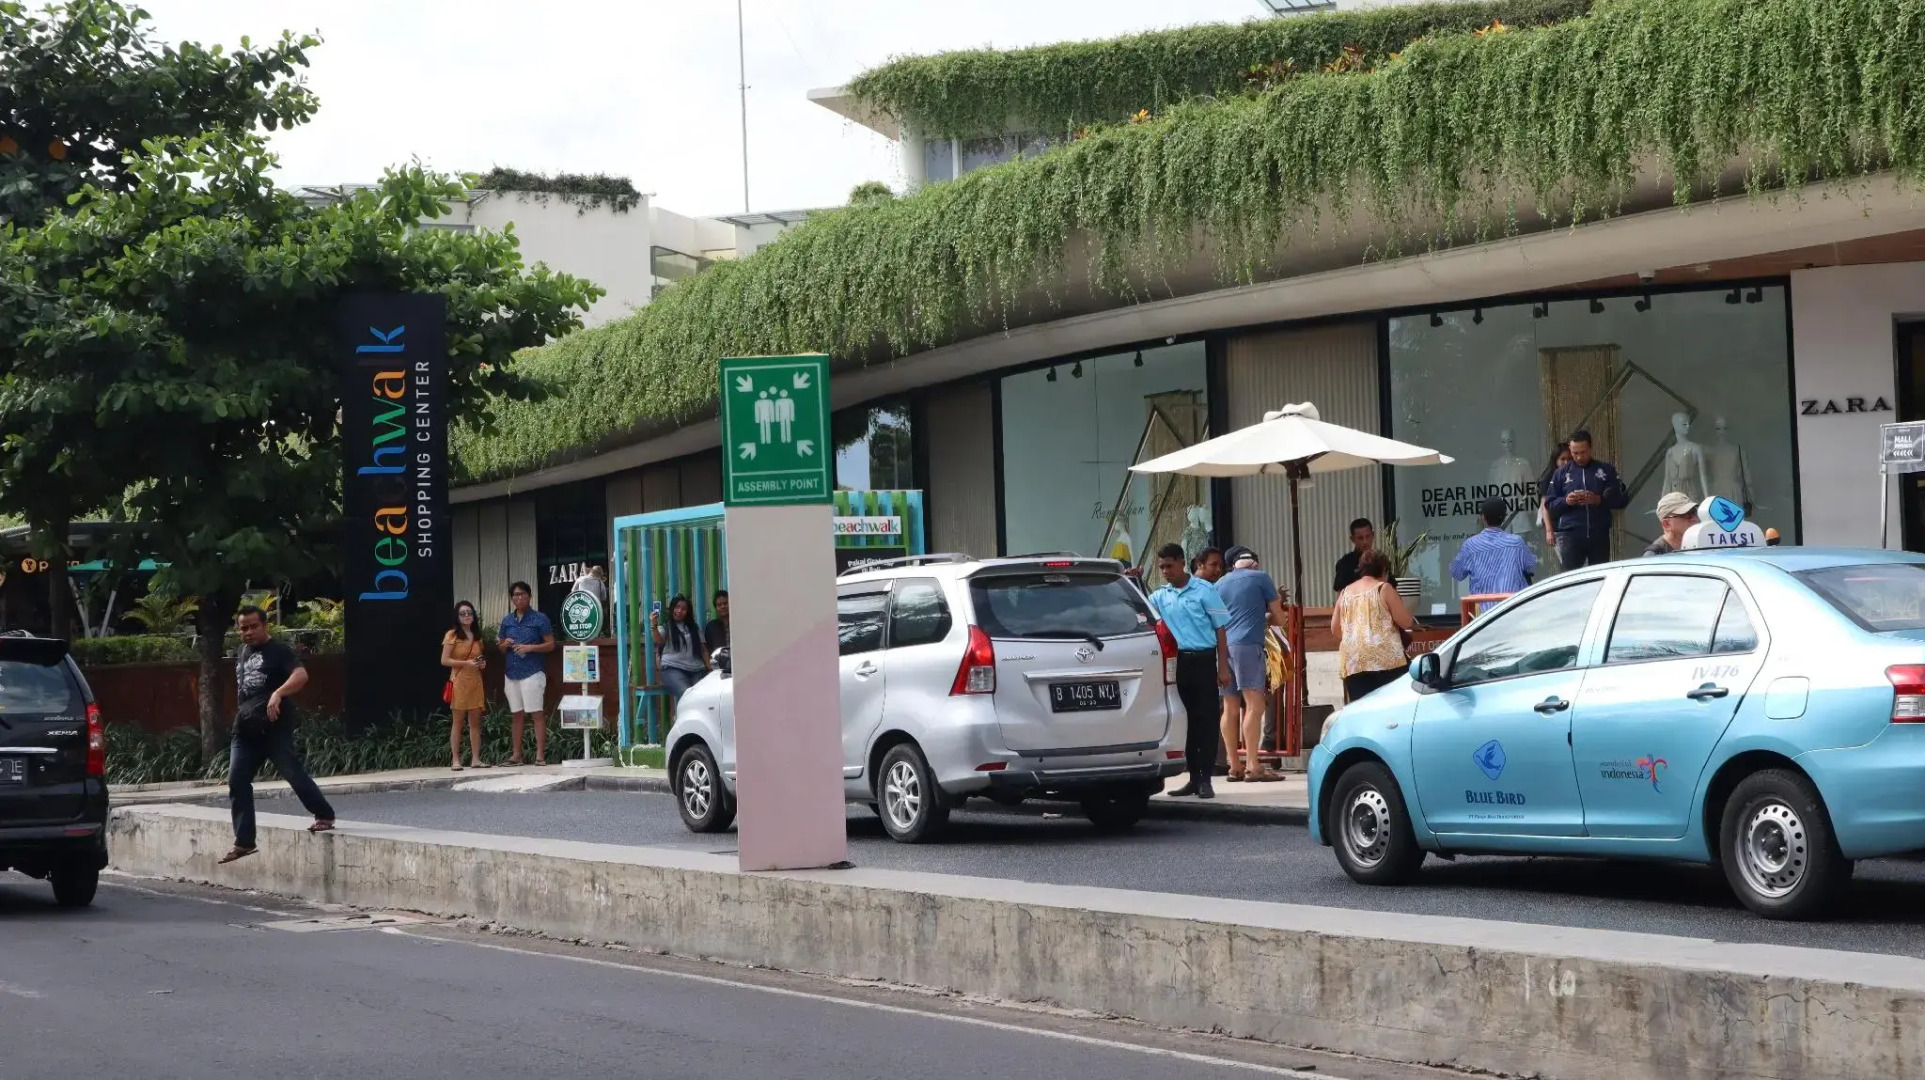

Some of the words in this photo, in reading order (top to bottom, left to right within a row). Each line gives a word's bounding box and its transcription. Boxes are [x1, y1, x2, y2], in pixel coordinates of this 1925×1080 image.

[415, 361, 430, 442] CENTER
[1800, 396, 1893, 415] ZARA
[1894, 435, 1913, 443] MALL
[737, 480, 787, 492] ASSEMBLY
[790, 478, 819, 490] POINT
[1421, 486, 1467, 503] DEAR
[416, 452, 432, 557] SHOPPING
[1422, 502, 1447, 517] WE
[1707, 532, 1755, 545] TAKSI
[1056, 687, 1063, 701] B
[1070, 686, 1094, 700] 1405
[1465, 790, 1495, 804] BLUE
[1496, 790, 1526, 805] BIRD
